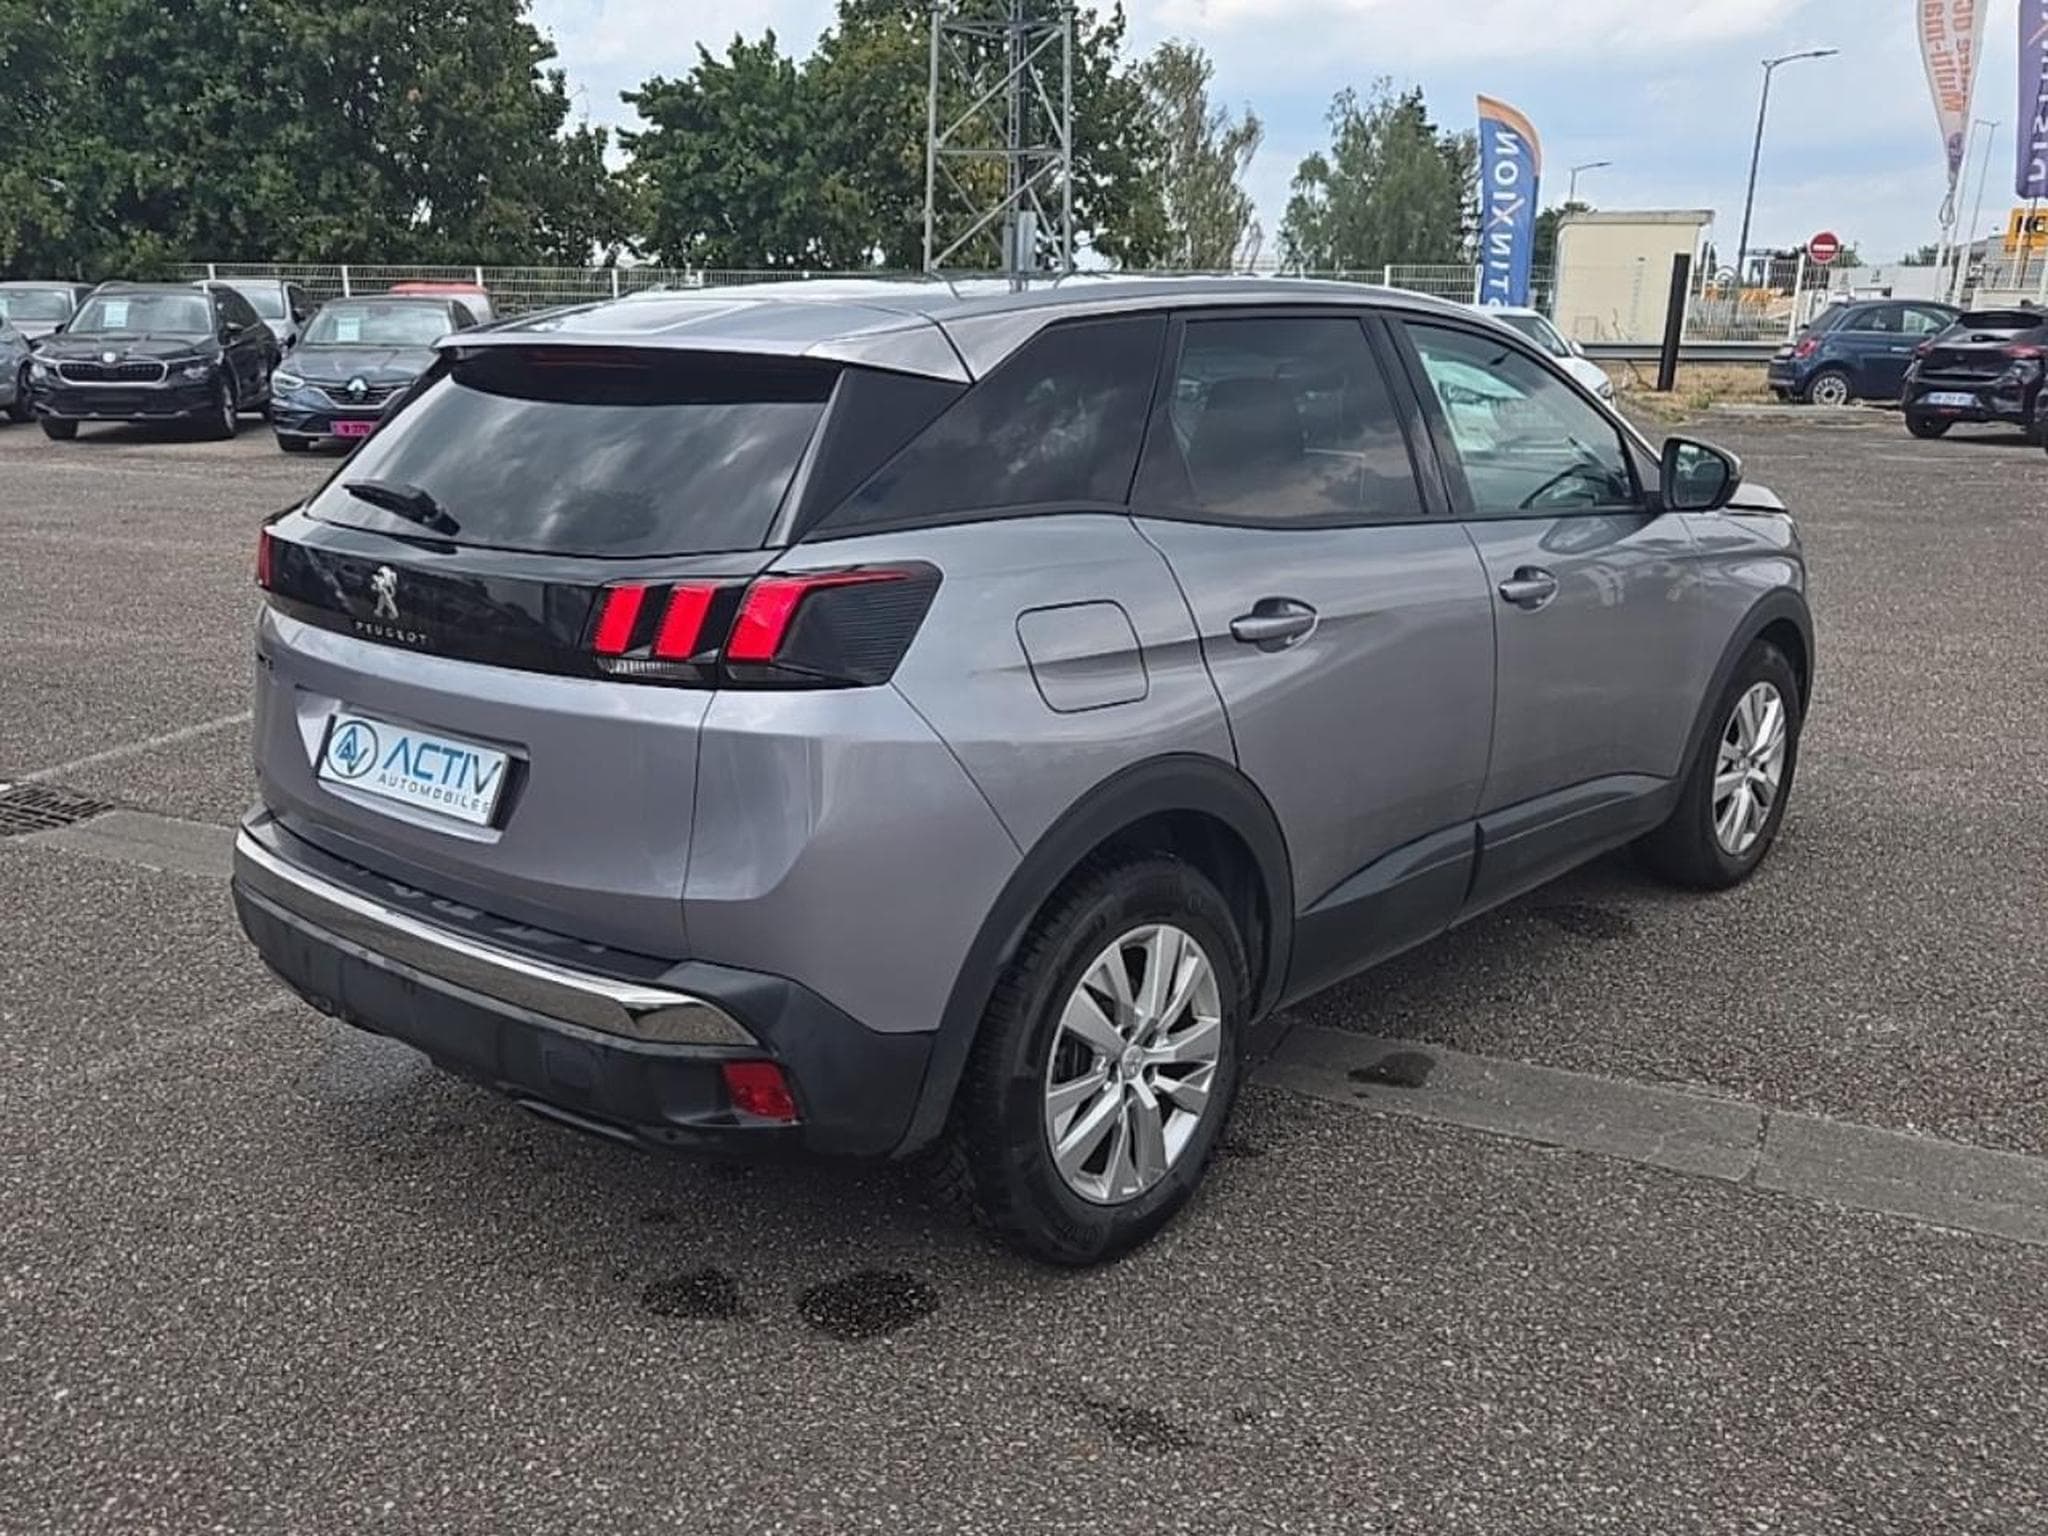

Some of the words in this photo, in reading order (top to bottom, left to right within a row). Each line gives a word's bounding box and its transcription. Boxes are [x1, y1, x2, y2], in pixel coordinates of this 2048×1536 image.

[355, 621, 427, 645] PEUGEOT
[382, 736, 502, 795] ACTIV
[377, 772, 491, 814] AUTOMOBILES
